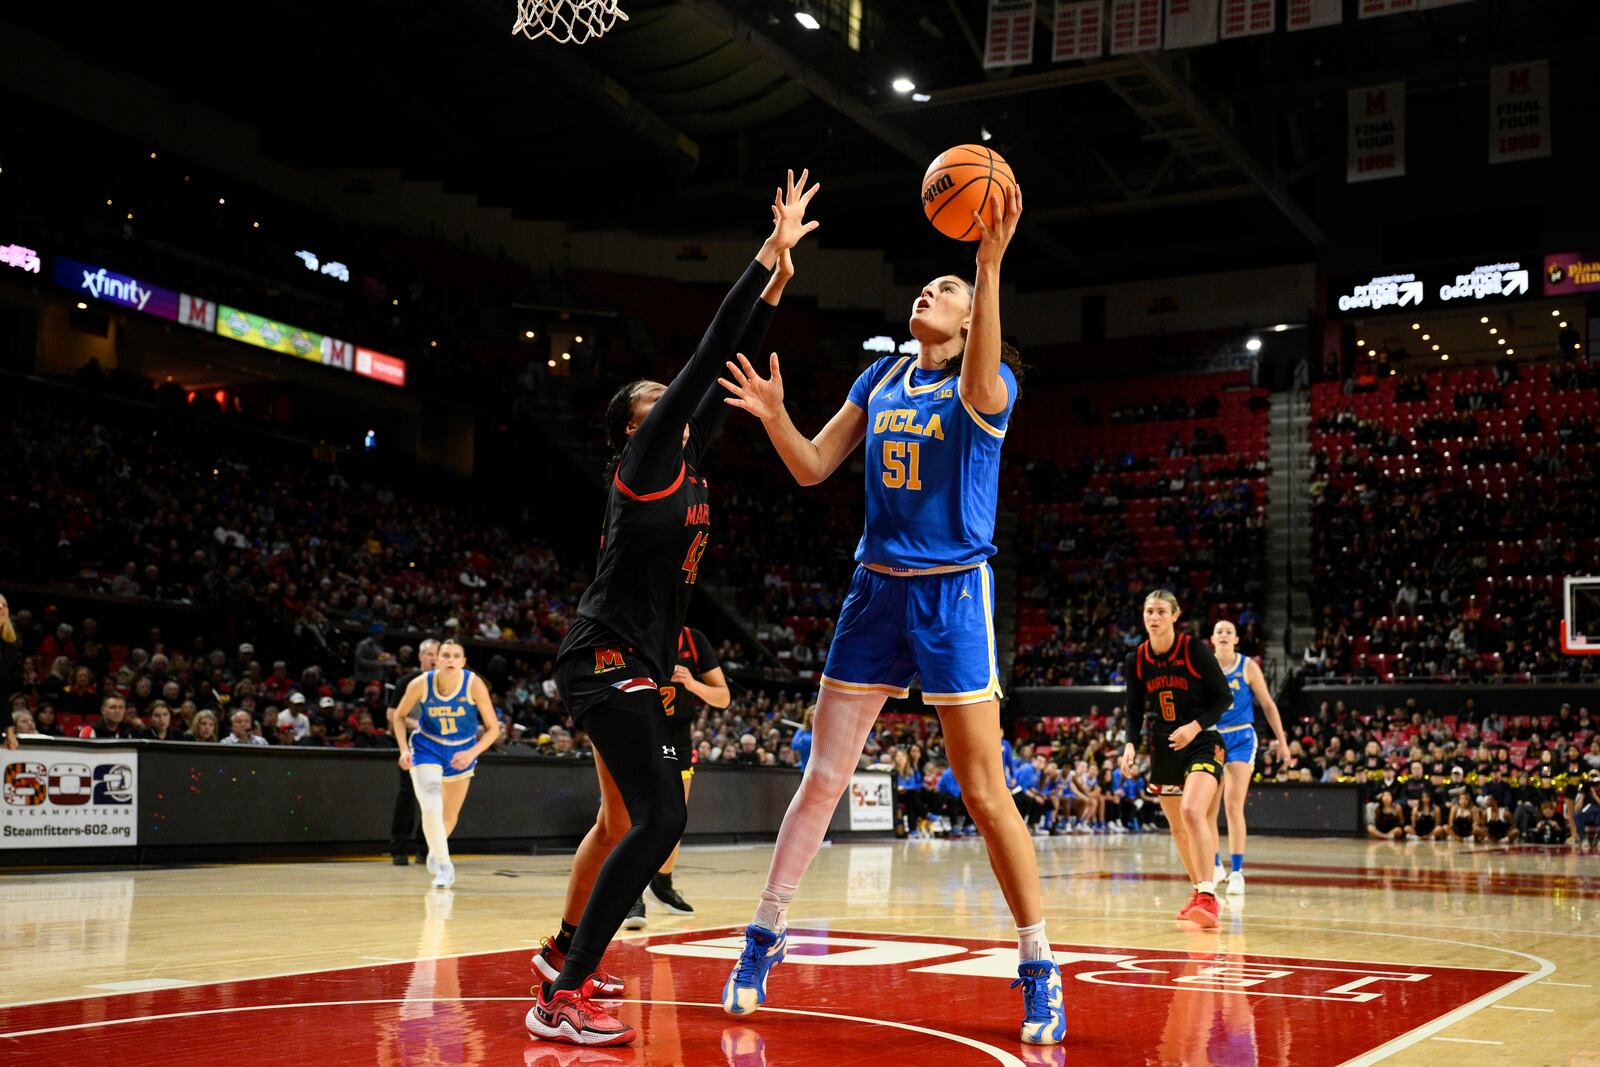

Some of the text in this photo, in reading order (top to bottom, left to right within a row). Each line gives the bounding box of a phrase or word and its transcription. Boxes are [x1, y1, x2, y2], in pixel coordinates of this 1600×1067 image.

[1496, 98, 1542, 117] FINAL
[1354, 120, 1397, 137] FINAL
[1498, 113, 1540, 130] FOUR
[1357, 135, 1394, 149] FOUR
[81, 268, 152, 311] xfinity
[188, 297, 208, 325] M
[329, 338, 346, 368] M
[873, 408, 945, 441] UCLA
[882, 440, 922, 491] 51
[594, 646, 626, 671] M
[1146, 675, 1188, 695] MARYLAND
[428, 706, 466, 718] UCLA
[1159, 690, 1176, 722] 6
[439, 717, 458, 735] 11
[3, 762, 133, 806] 602
[5, 808, 130, 816] STEAMFITTERS
[3, 823, 131, 838] Steamfitters-602.org
